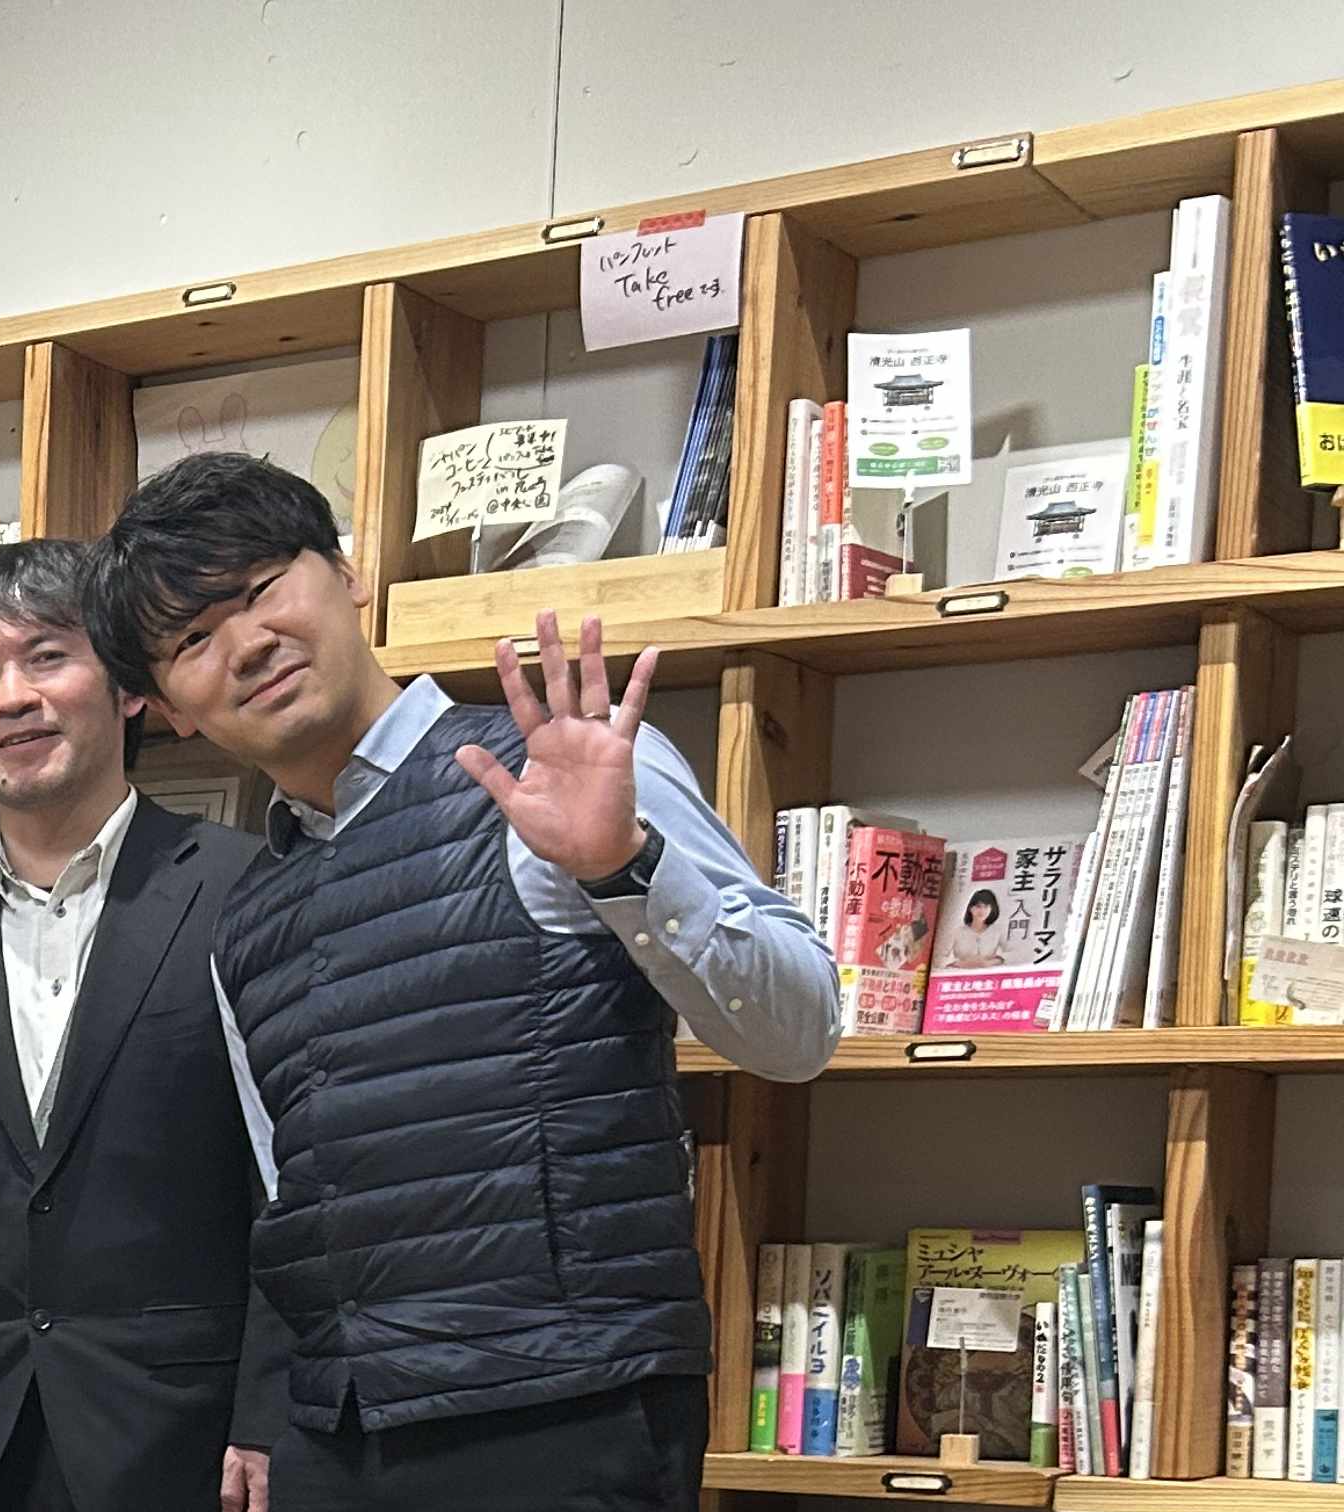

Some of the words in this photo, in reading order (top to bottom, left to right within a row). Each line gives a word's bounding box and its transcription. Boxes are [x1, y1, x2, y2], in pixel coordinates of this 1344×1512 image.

[614, 266, 669, 297] Take
[651, 285, 694, 311] free
[845, 862, 865, 915] 不動産
[870, 850, 944, 900] 不動産
[916, 1242, 985, 1263] ミュシャ
[809, 1269, 832, 1375] ソバニイルヨ
